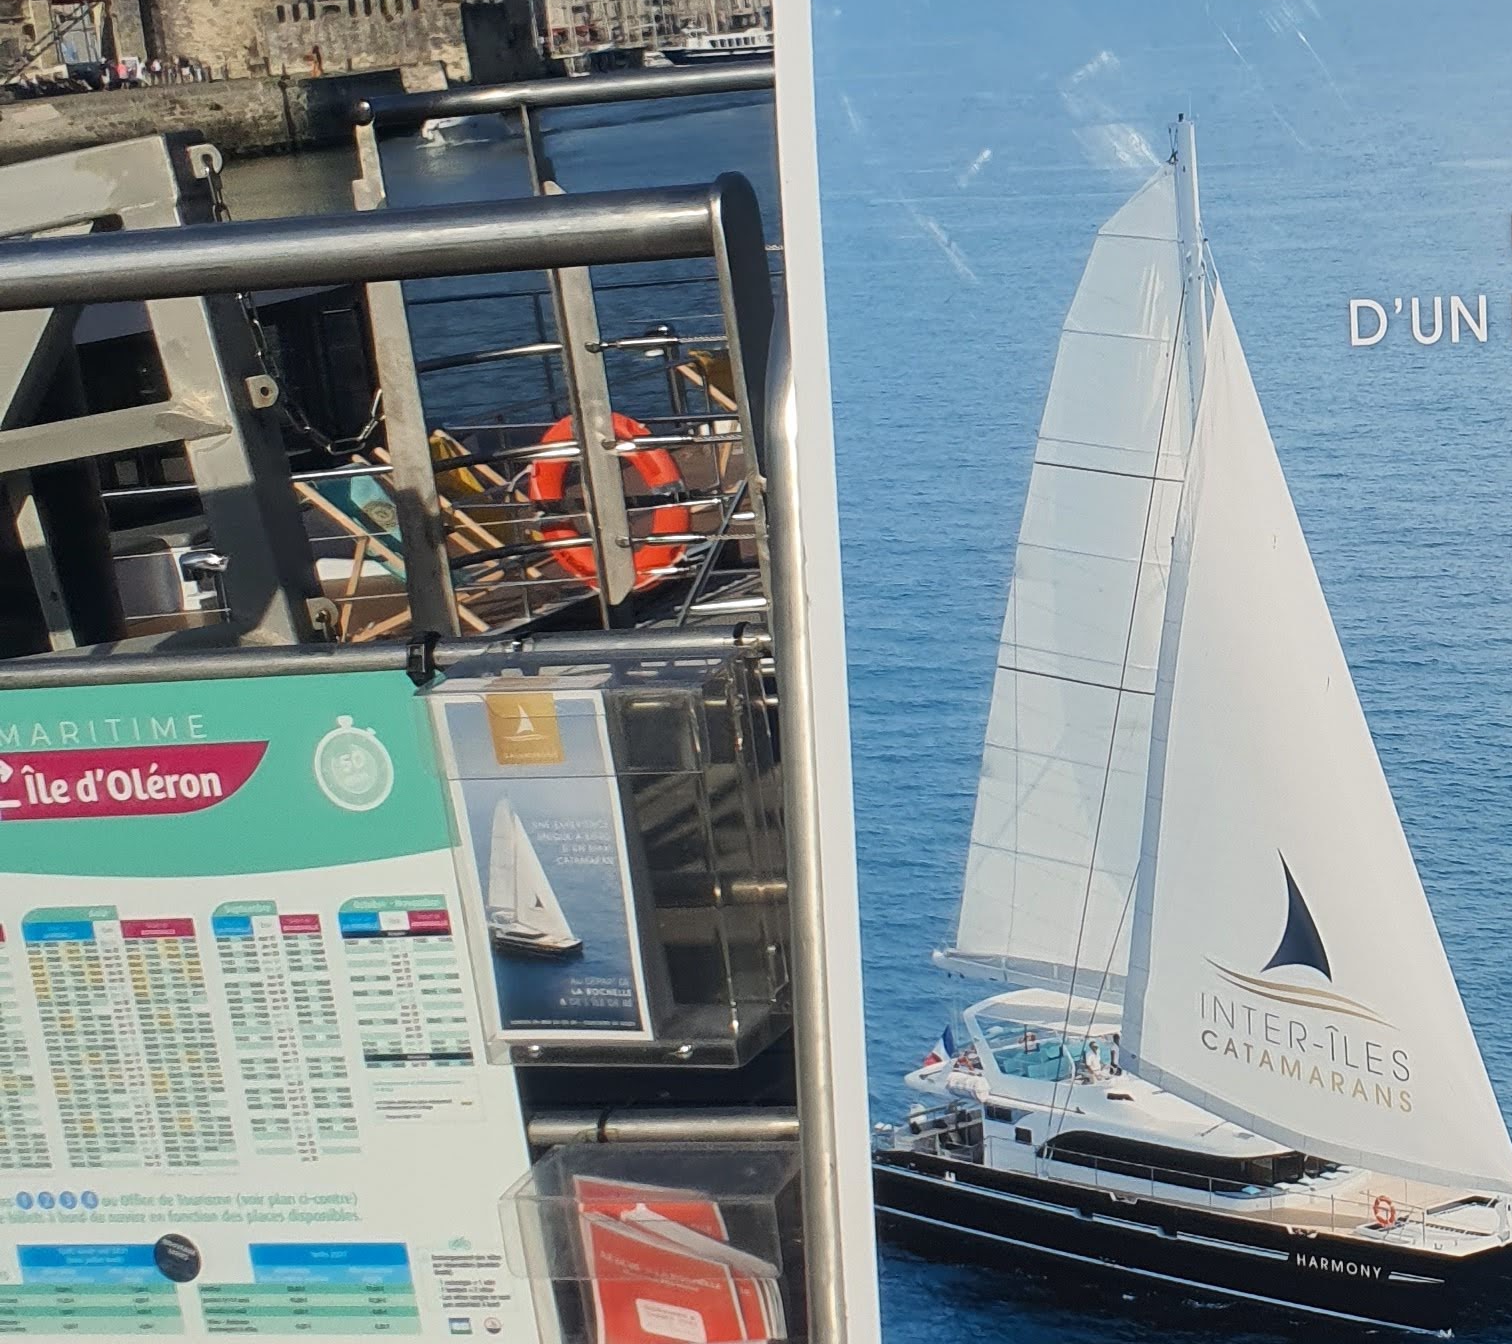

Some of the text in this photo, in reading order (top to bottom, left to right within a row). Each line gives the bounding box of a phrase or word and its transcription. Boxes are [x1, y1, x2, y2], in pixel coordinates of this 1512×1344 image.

[1350, 293, 1488, 348] D'UN
[0, 714, 207, 748] MARITIME
[21, 761, 223, 806] Île d'Oléron
[1200, 991, 1411, 1083] INTER-ÎLES
[1201, 1028, 1413, 1113] CATAMARANS
[1296, 1252, 1383, 1280] HARMONY
